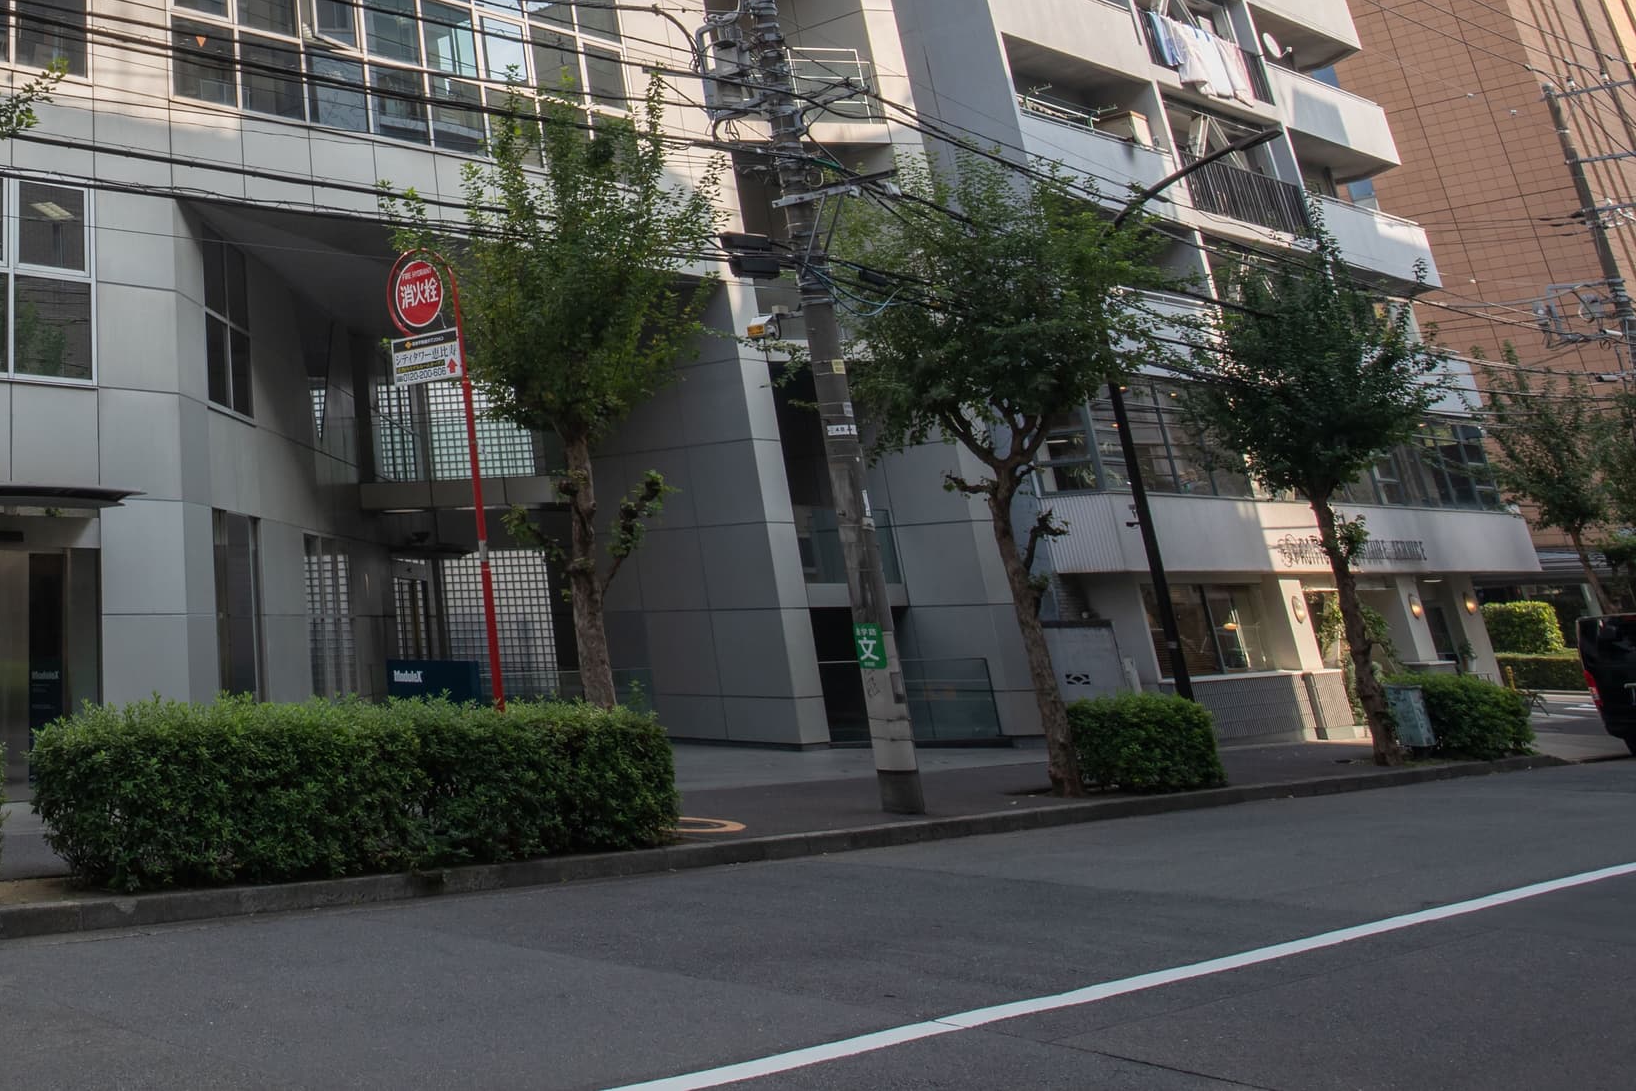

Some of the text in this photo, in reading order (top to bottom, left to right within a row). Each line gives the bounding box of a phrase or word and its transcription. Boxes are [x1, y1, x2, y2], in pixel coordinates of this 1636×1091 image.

[400, 277, 439, 309] 消火栓
[858, 636, 880, 661] 文
[393, 669, 424, 683] ModuleX
